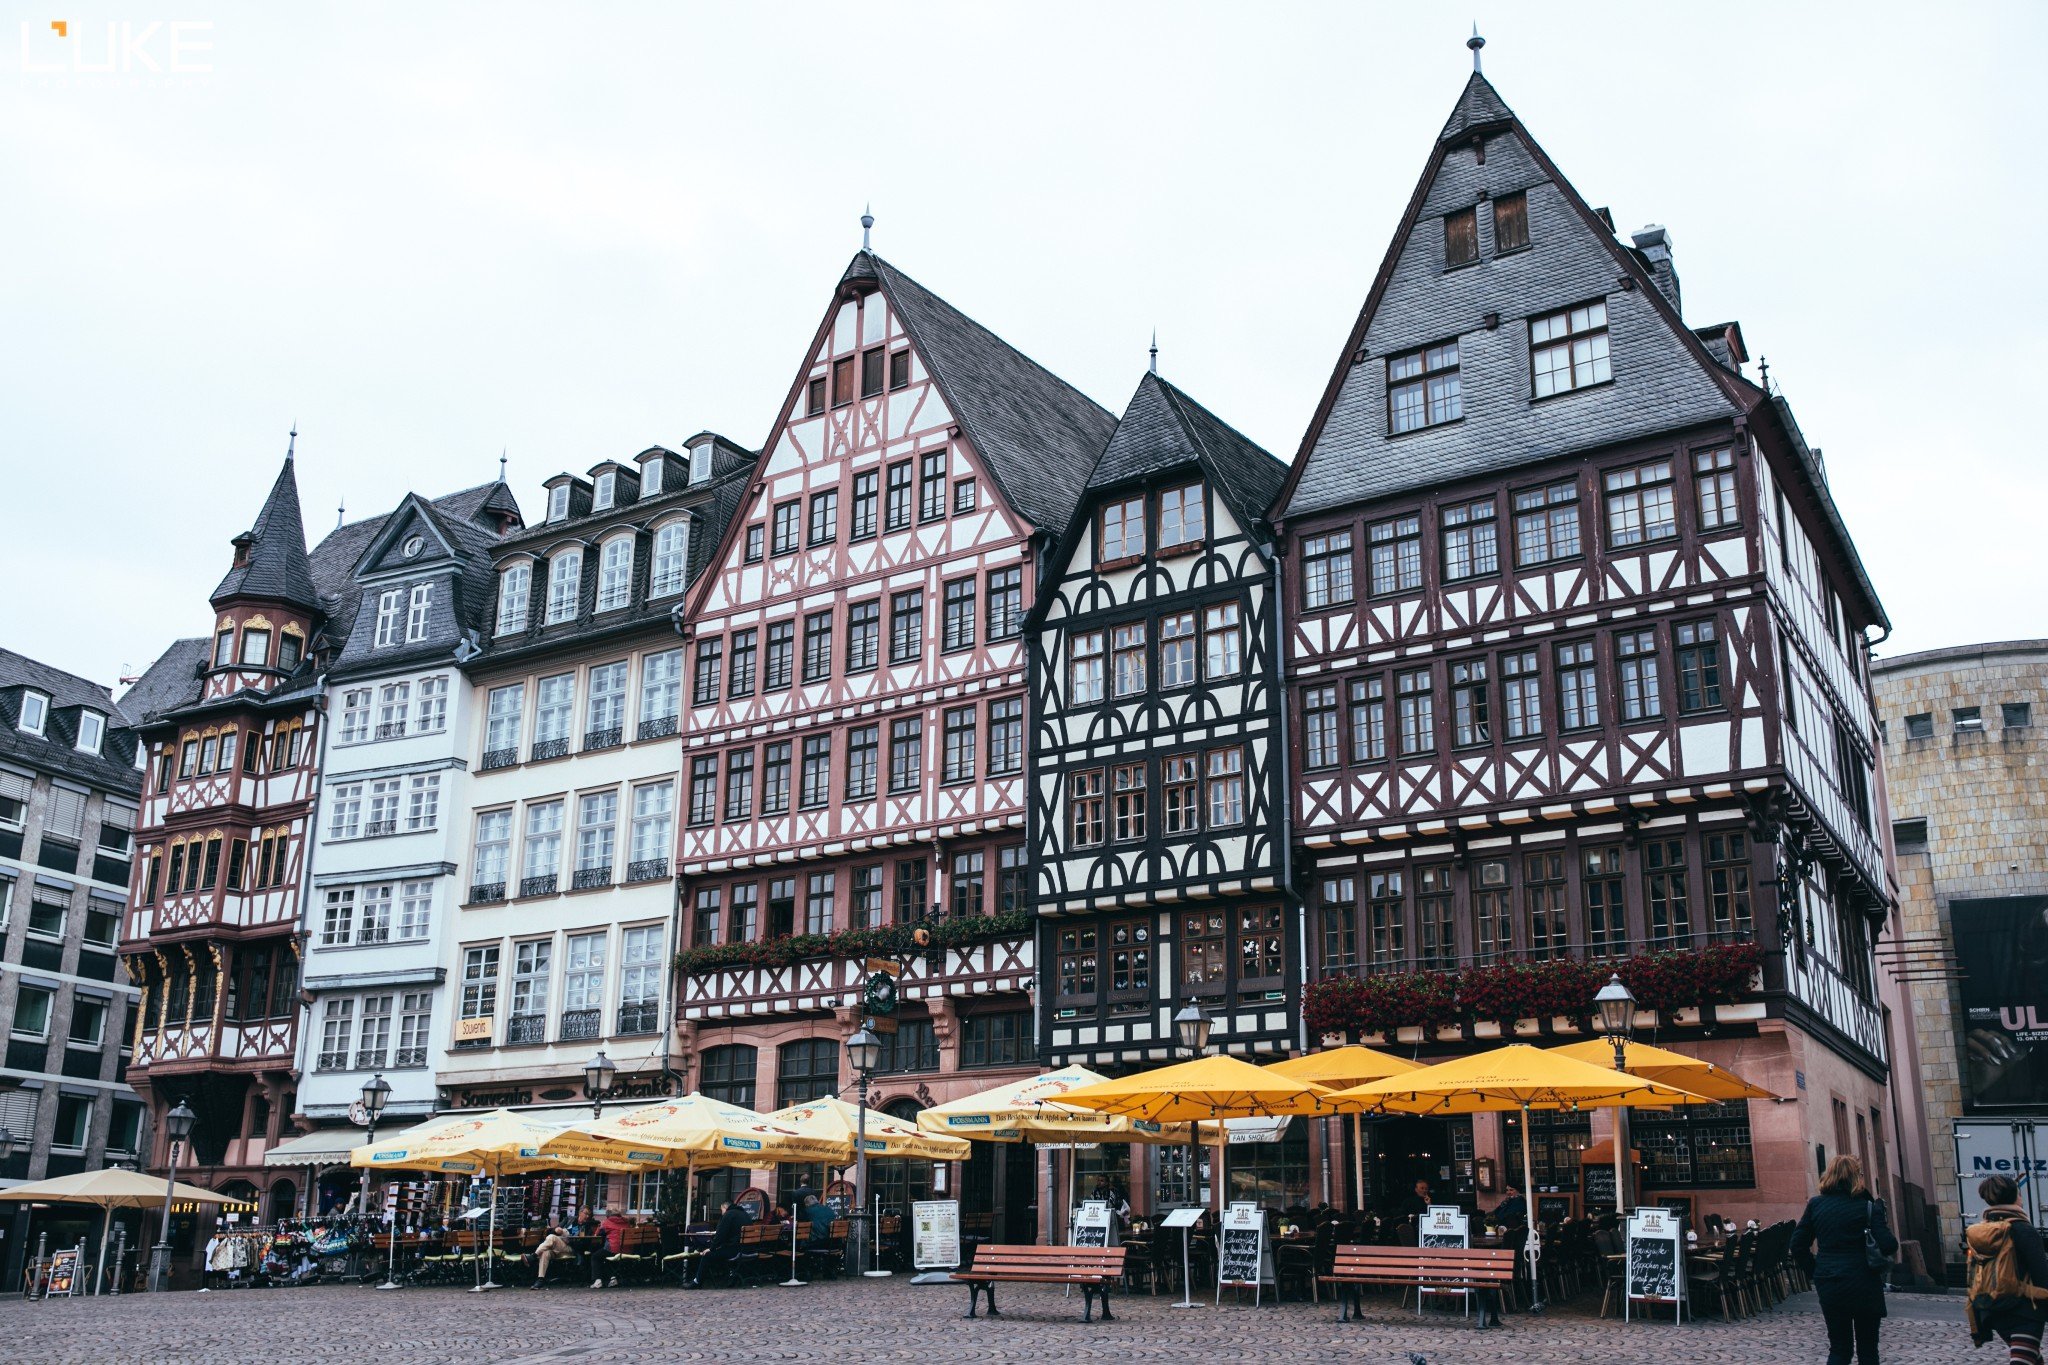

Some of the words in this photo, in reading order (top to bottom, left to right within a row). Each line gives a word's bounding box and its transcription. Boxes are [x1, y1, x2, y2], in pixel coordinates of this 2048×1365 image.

[462, 1021, 486, 1035] Souvenirs
[461, 1087, 533, 1107] Souvenirs
[952, 1116, 988, 1124] POSSMANN
[727, 1138, 758, 1149] POSSMANN
[1973, 1156, 2047, 1171] Neitz
